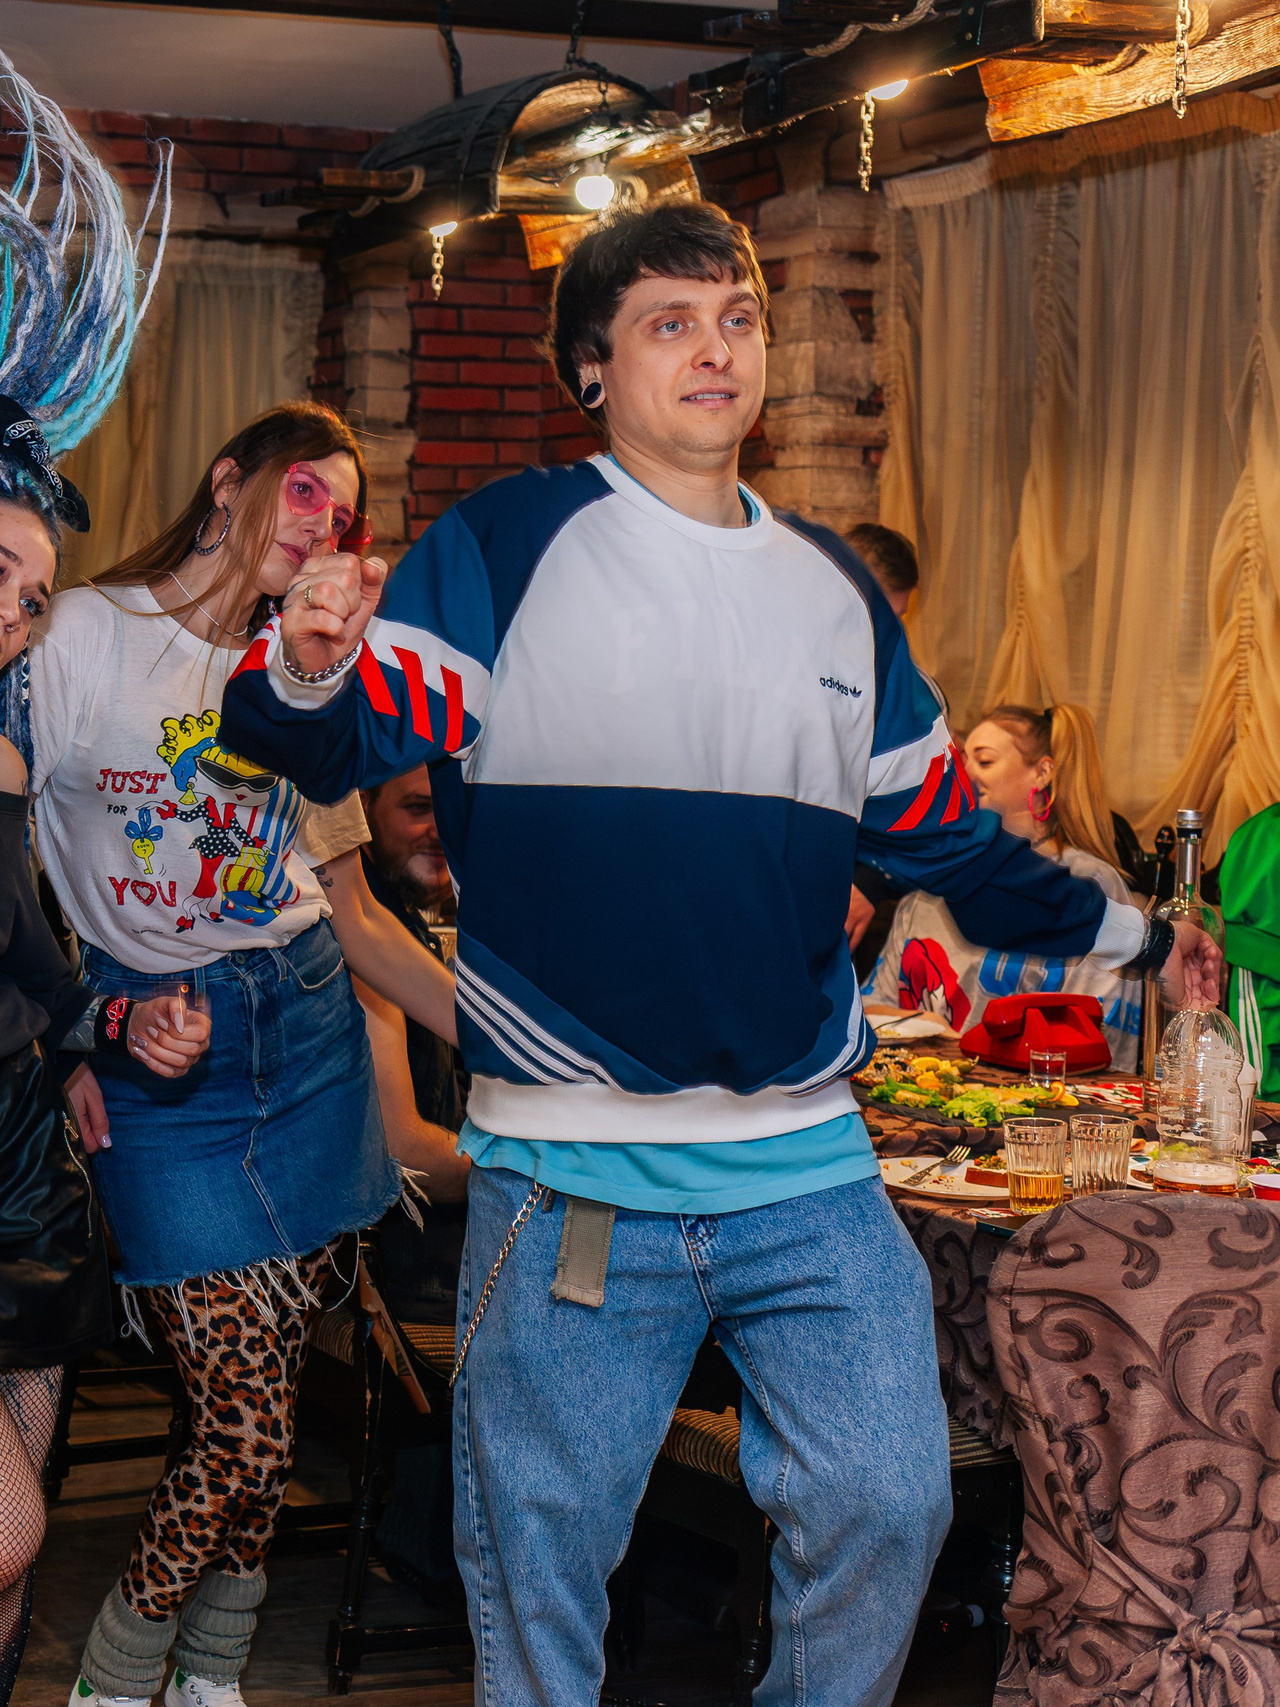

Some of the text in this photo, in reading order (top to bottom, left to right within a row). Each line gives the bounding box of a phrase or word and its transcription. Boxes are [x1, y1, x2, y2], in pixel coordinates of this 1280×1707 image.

[820, 677, 849, 696] adidas
[96, 768, 167, 795] JUST
[106, 804, 128, 816] FOR
[107, 876, 177, 908] YOU
